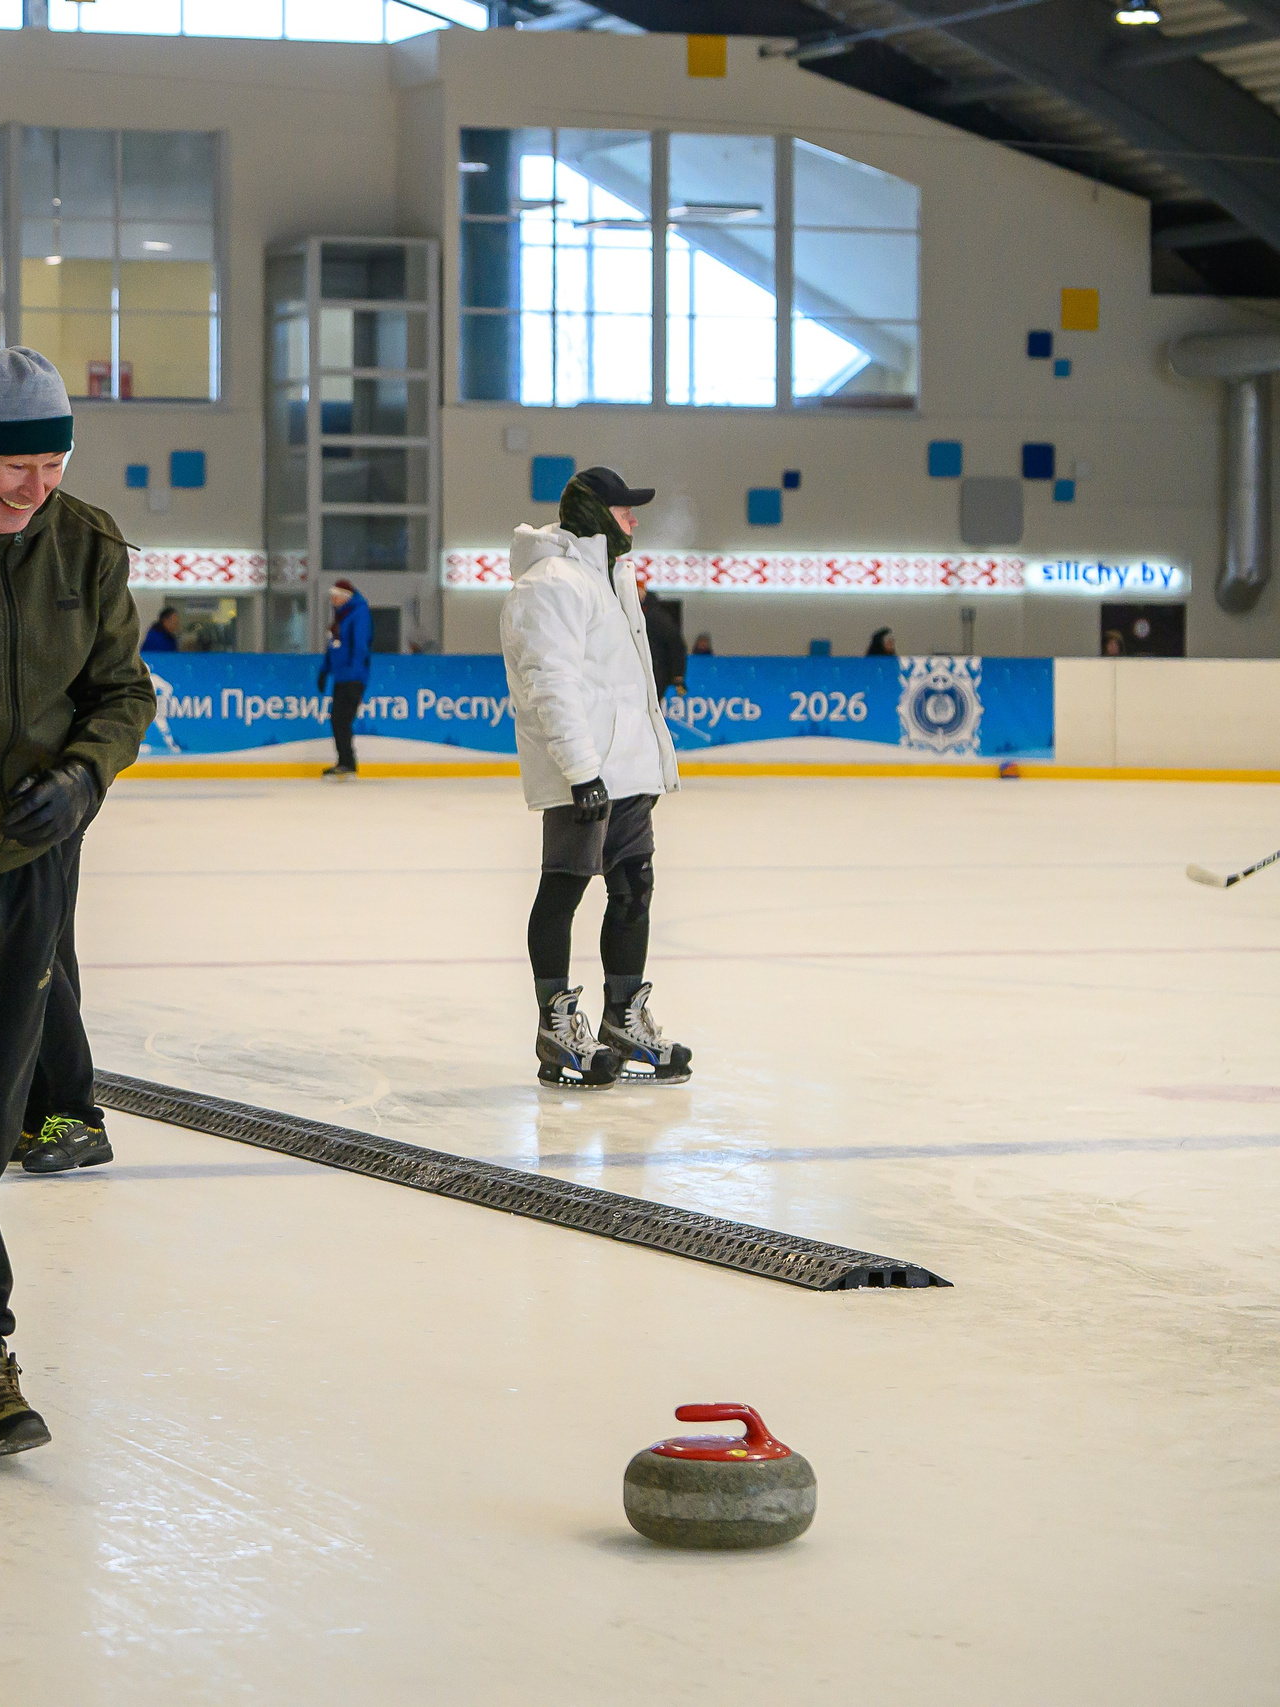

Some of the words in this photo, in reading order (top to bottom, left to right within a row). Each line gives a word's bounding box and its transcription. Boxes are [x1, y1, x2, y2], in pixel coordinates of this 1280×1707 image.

[1041, 559, 1175, 589] silichy.by
[221, 687, 409, 727] Президнта
[788, 690, 868, 723] 2026
